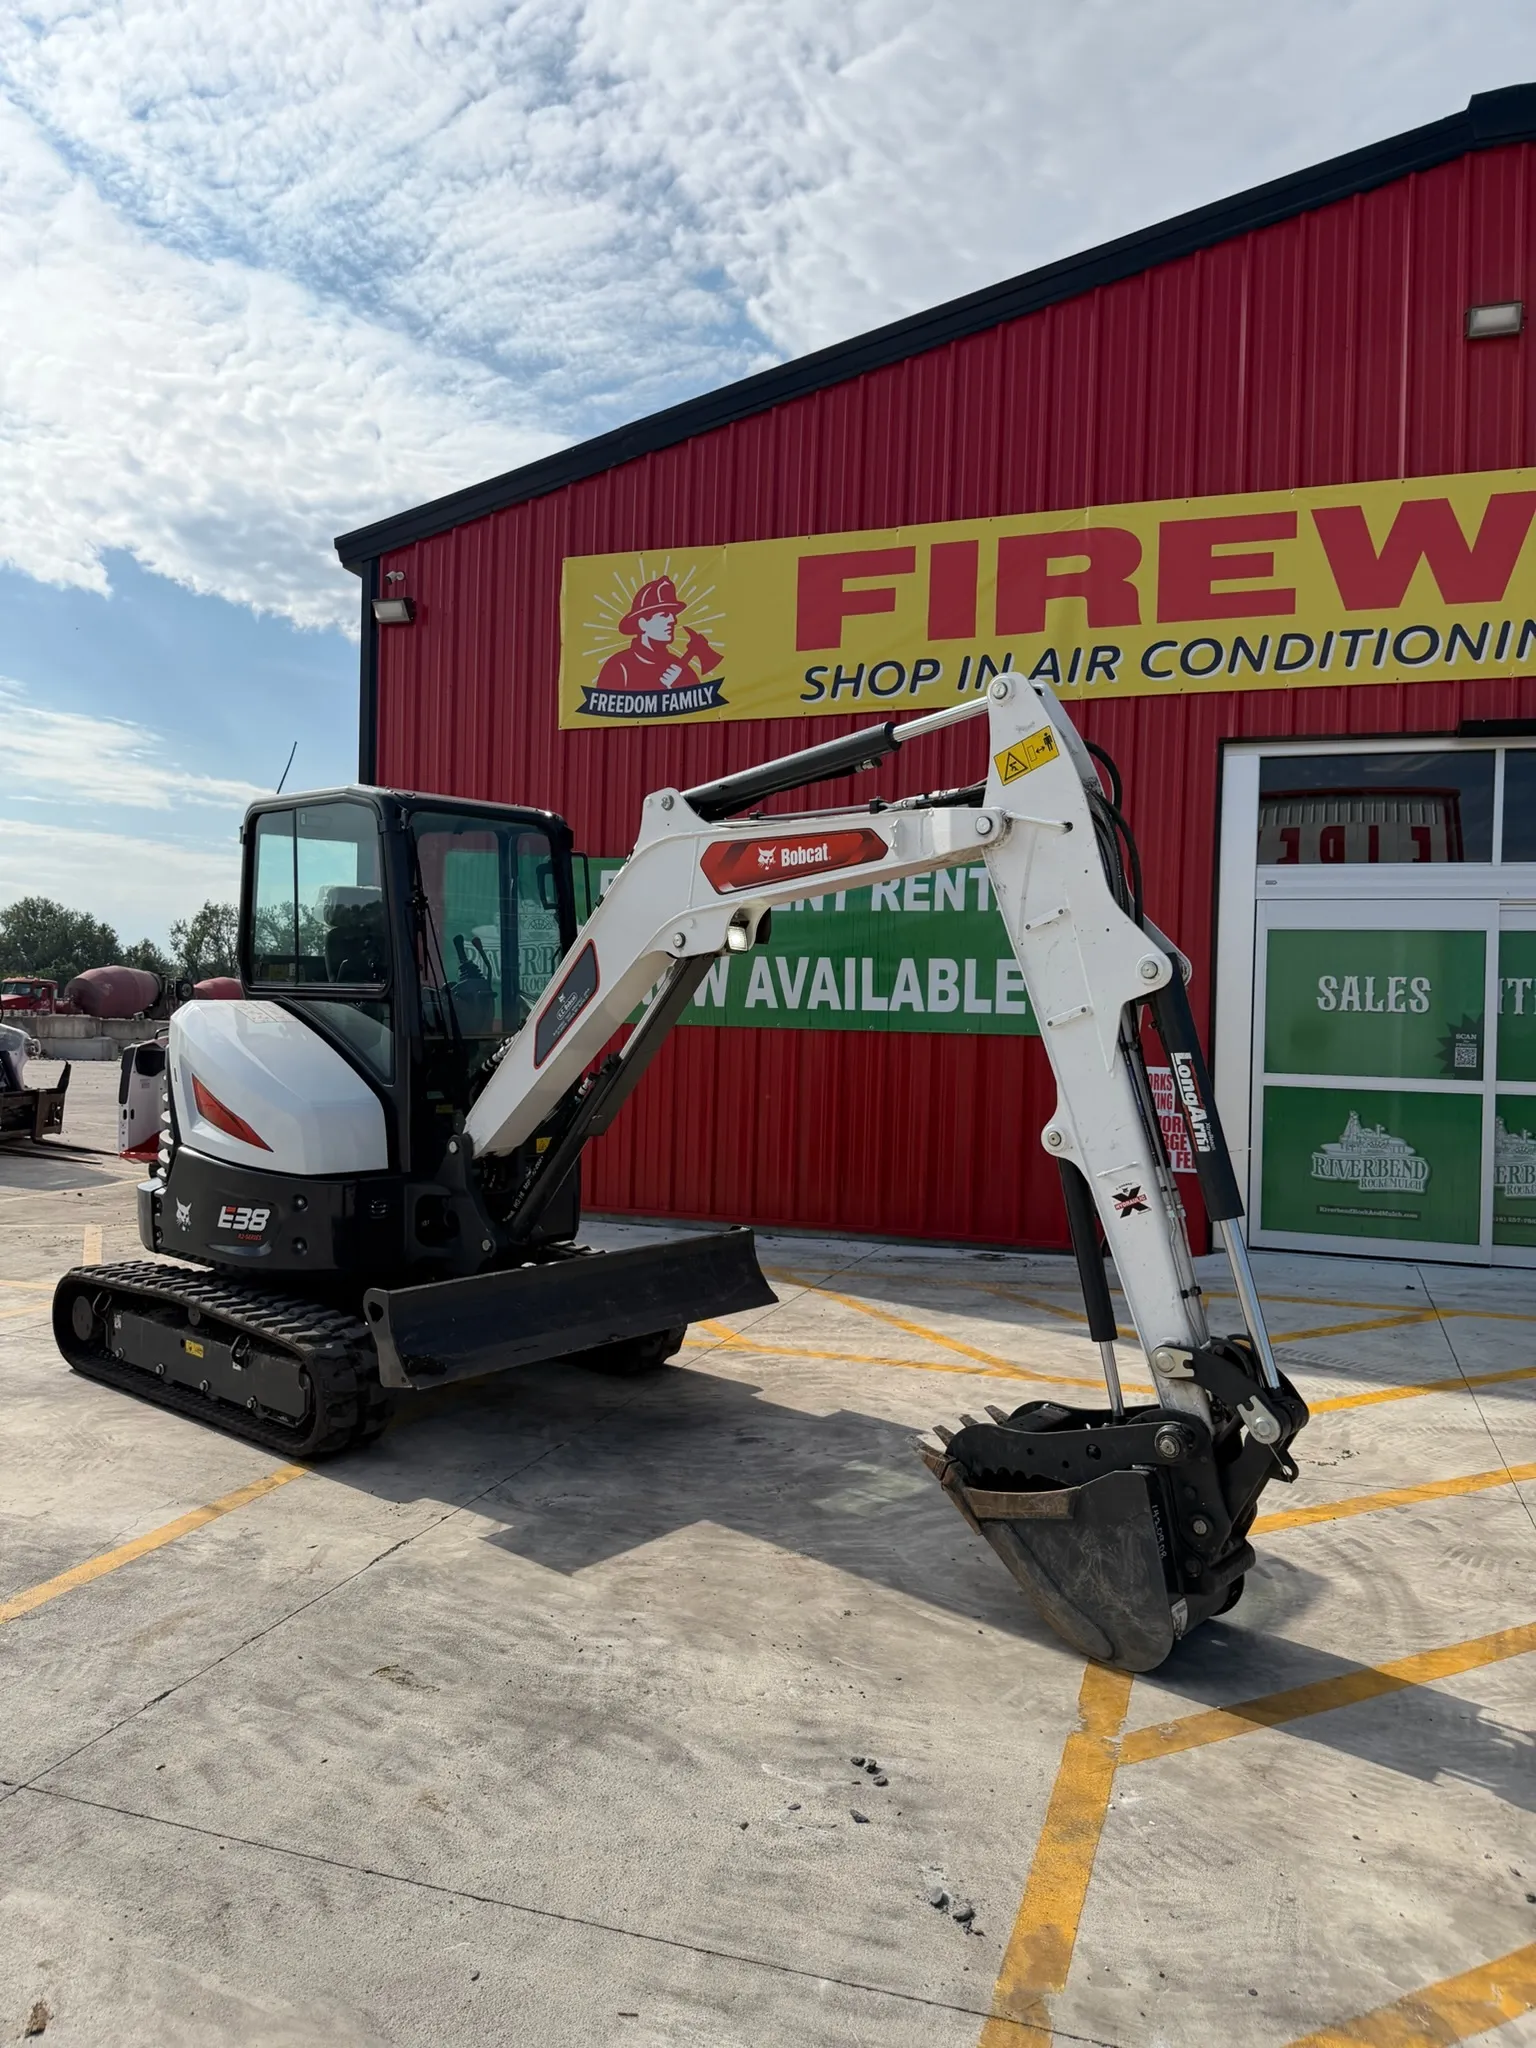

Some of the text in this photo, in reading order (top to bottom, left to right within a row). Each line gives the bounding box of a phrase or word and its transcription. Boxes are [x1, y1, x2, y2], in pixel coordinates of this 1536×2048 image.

[800, 658, 941, 701] SHOP
[957, 652, 1013, 692] IN
[1029, 645, 1122, 685] AIR
[589, 685, 714, 714] FREEDOM FAMILY
[781, 843, 828, 867] Bobcat
[871, 867, 1000, 912] RENT
[744, 956, 1026, 1015] AVAILABLE
[1316, 975, 1432, 1014] SALES
[1173, 1052, 1211, 1152] LongArm
[1314, 1156, 1425, 1179] RIVERBEND
[217, 1205, 270, 1232] E38
